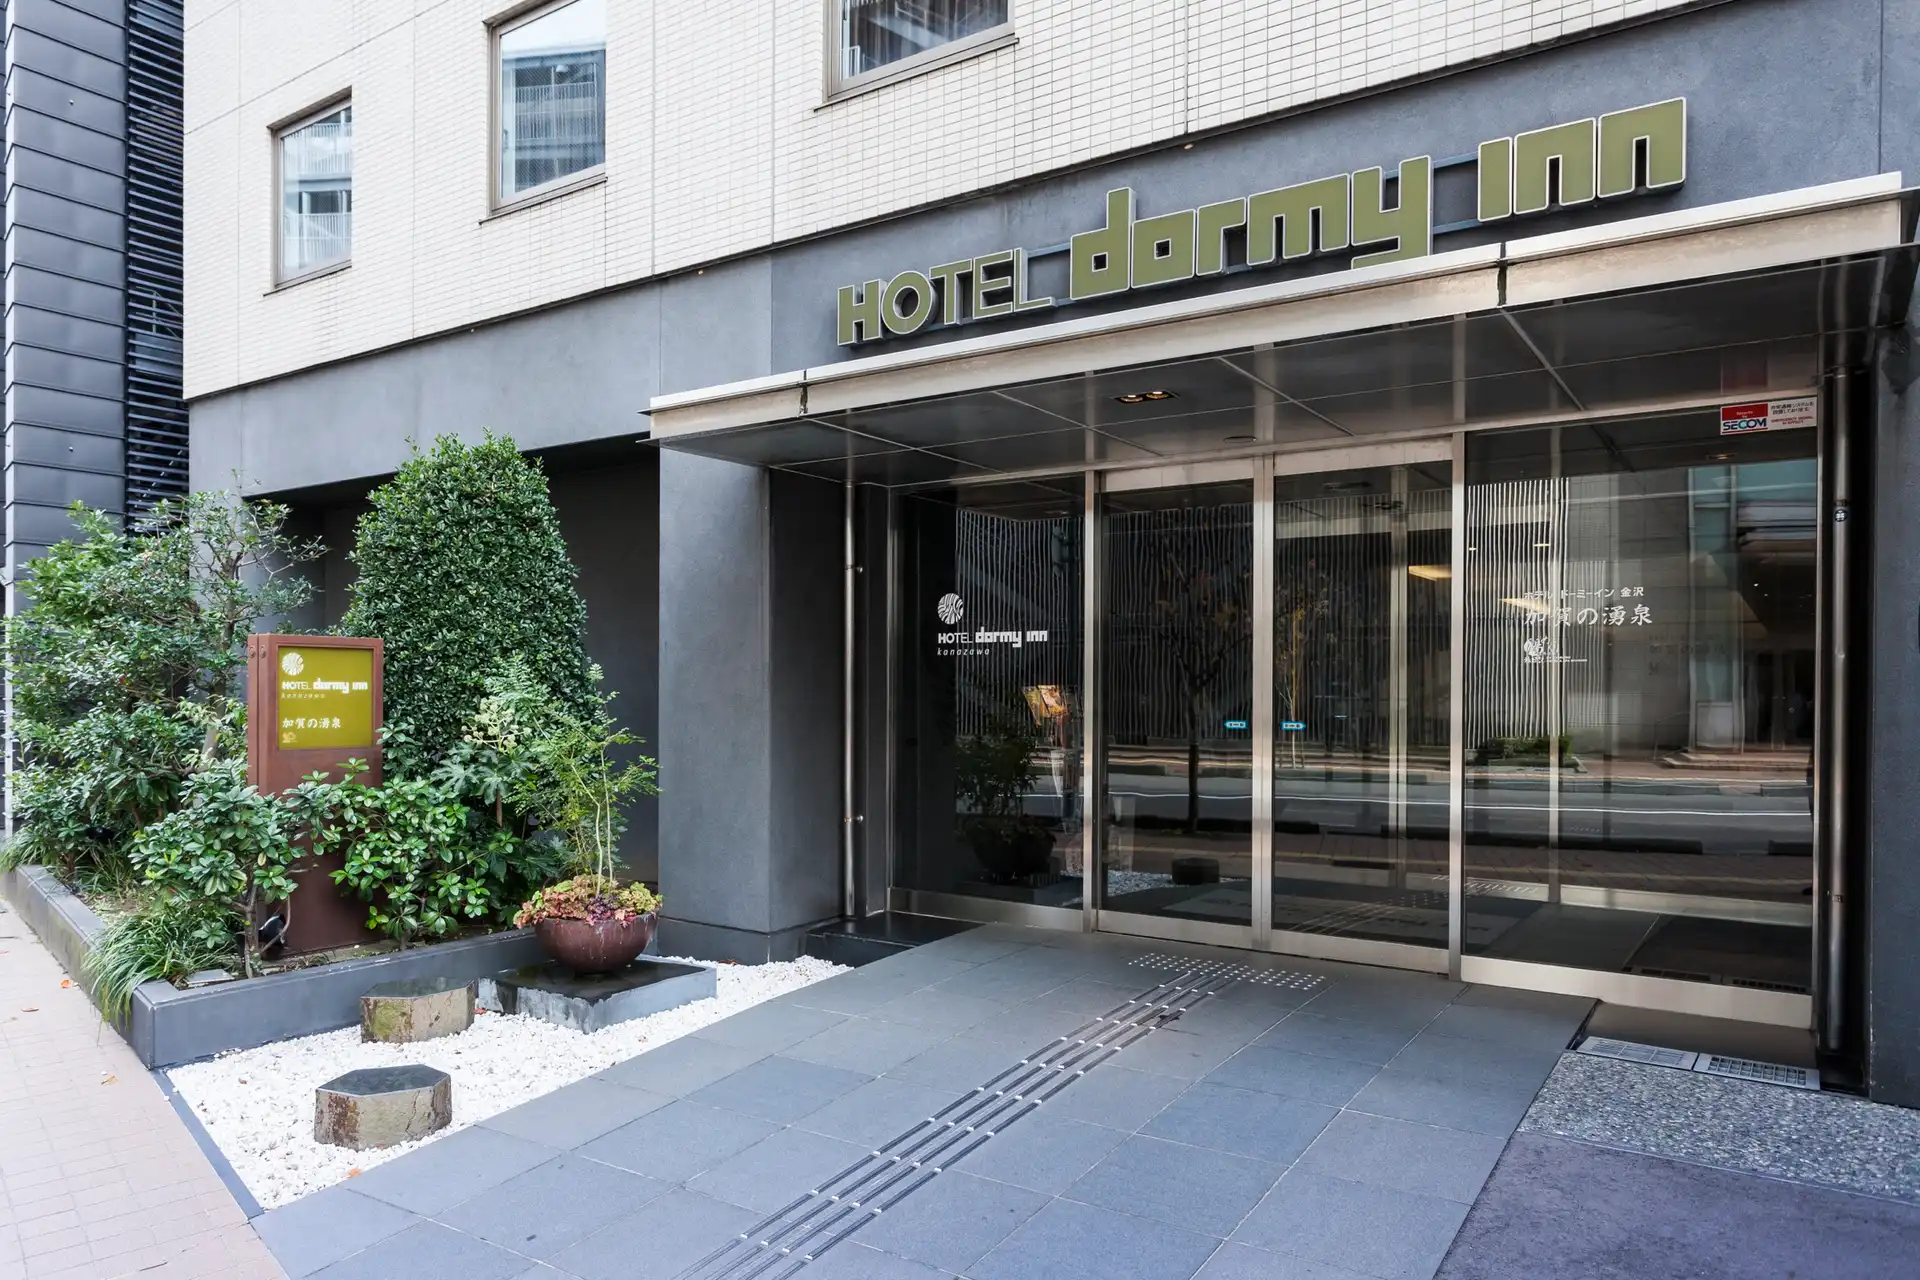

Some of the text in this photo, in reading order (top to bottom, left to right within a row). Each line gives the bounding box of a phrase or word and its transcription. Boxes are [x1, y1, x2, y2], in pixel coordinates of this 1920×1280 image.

[837, 96, 1687, 346] HOTEL dormy inn
[1722, 418, 1767, 431] SECOM
[1561, 588, 1615, 600] ドーミーイン
[1620, 586, 1644, 598] 金沢
[938, 626, 1048, 648] HOTEL dormy inn
[937, 648, 990, 656] kanazawa
[282, 677, 368, 694] HOTEL dormy inn
